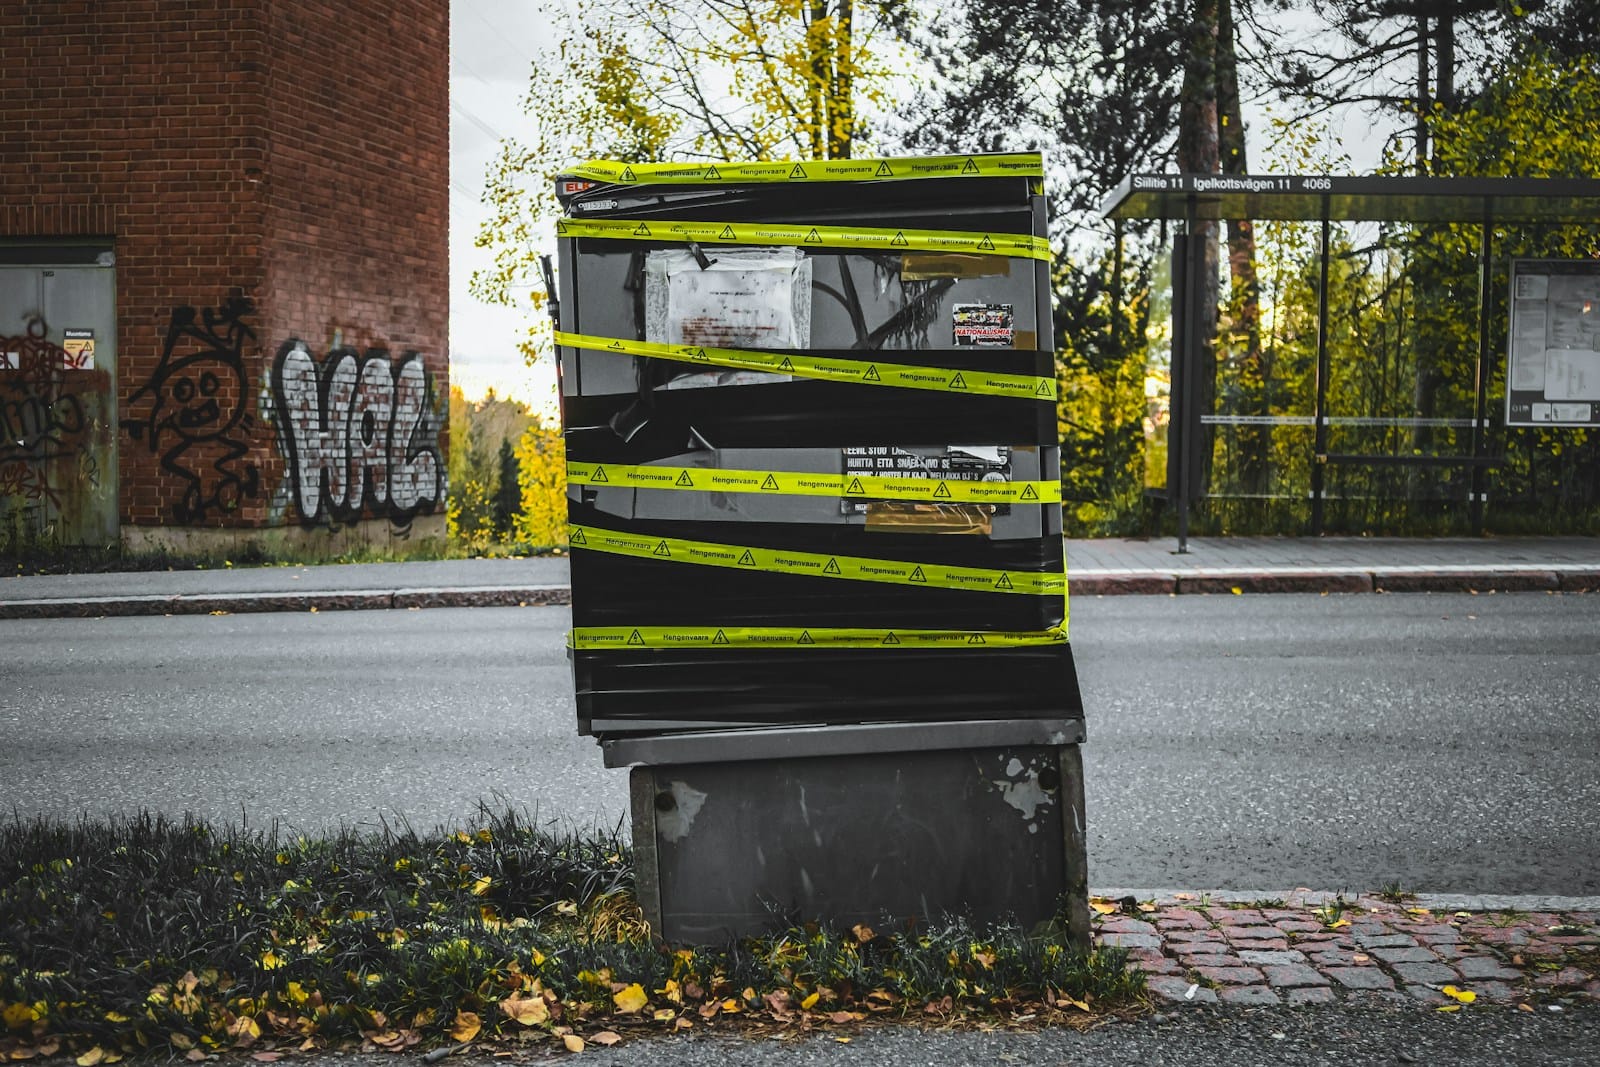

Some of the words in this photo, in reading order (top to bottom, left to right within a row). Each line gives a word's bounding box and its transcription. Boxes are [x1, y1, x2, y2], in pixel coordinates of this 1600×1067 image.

[655, 170, 701, 178] Hengenvaara
[740, 168, 786, 176] Hengenvaara
[826, 166, 873, 174] Hengenvaara
[912, 163, 959, 172] Hengenvaara
[1171, 177, 1184, 189] 11
[1193, 176, 1275, 192] Igelkottsvägen
[1278, 177, 1291, 190] 11
[1302, 178, 1332, 190] 4066
[755, 231, 803, 239] Hengenvaara
[841, 234, 888, 242] Hengenvaara
[928, 237, 975, 246] Hengenvaara
[814, 363, 861, 375] Hengenvaara
[900, 372, 947, 383] Hengenvaara
[986, 379, 1034, 391] Hengenvaara
[627, 472, 673, 482] Hengenvaara
[712, 476, 758, 486] Hengenvaara
[798, 479, 844, 490] Hengenvaara
[883, 484, 931, 493] Hengenvaara
[970, 487, 1017, 497] Hengenvaara
[606, 537, 651, 549] Hengenvaara
[690, 548, 736, 560] Hengenvaara
[775, 557, 820, 569] Hengenvaara
[860, 565, 906, 576] Hengenvaara
[946, 573, 992, 584] Hengenvaara
[578, 633, 624, 642] Hengenvaara
[663, 633, 709, 642] Hengenvaara
[747, 634, 794, 642] Hengenvaara
